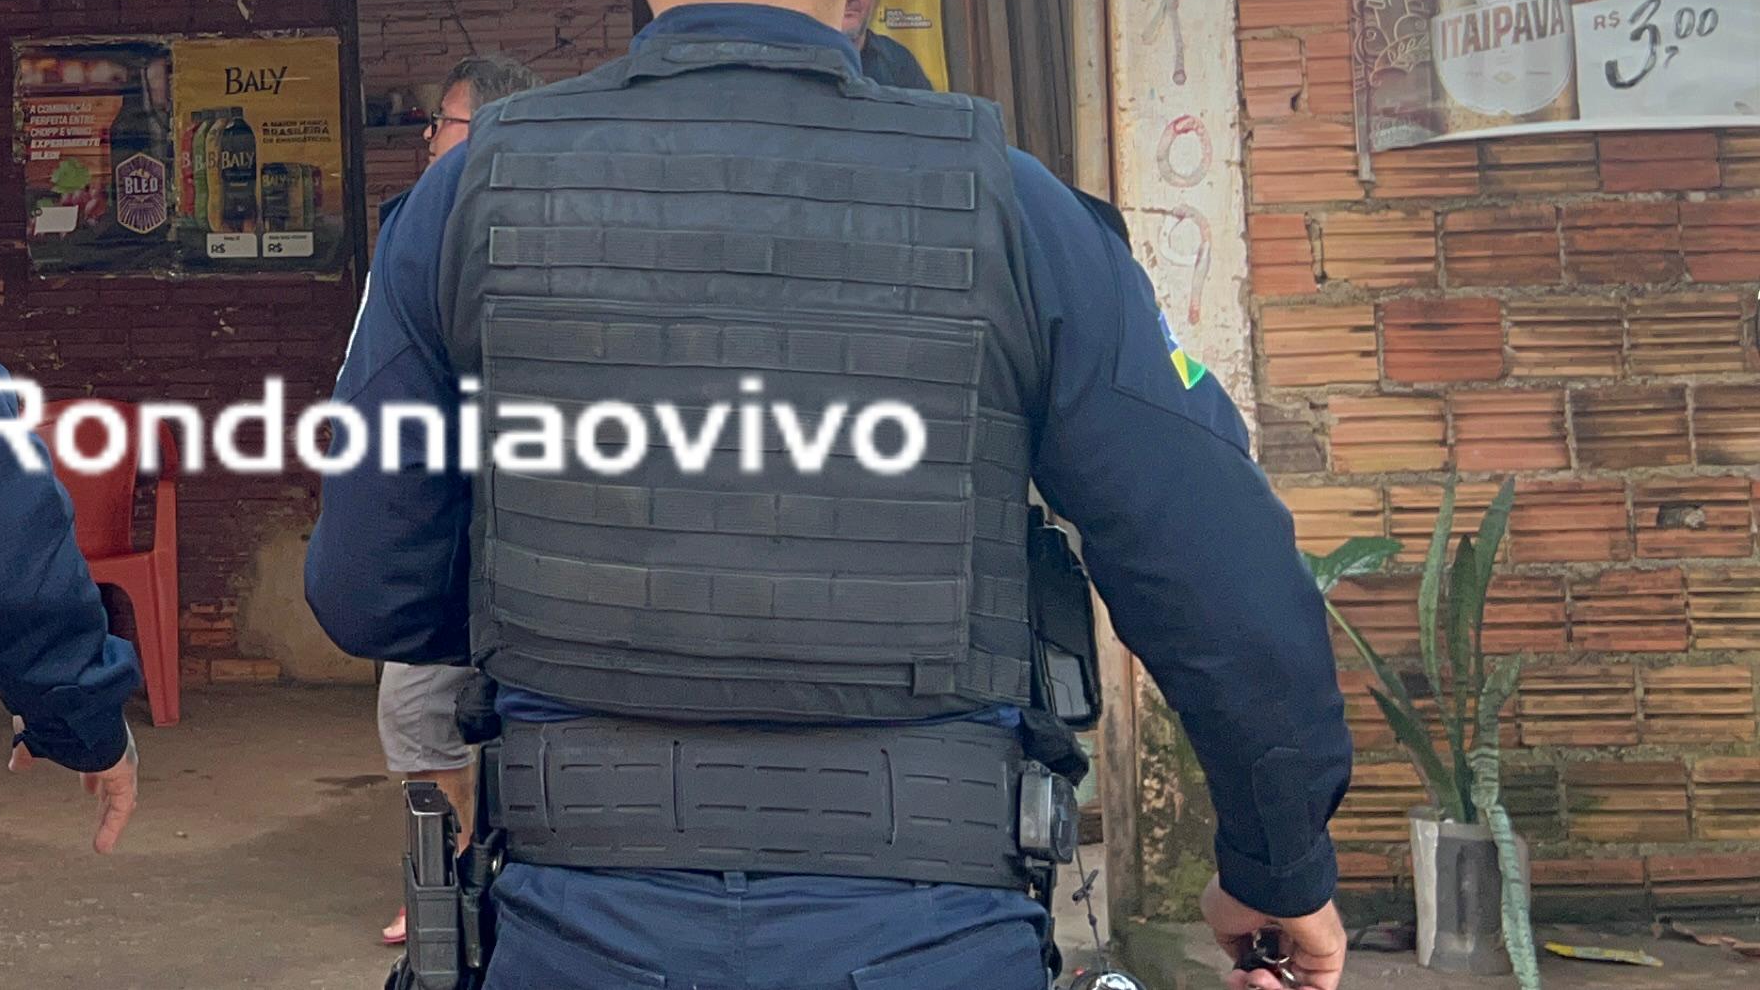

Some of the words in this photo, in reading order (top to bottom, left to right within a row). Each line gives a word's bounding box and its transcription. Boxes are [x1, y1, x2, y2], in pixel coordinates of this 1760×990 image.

[1593, 10, 1621, 31] R$
[224, 66, 288, 95] BALY
[221, 150, 255, 169] BALY
